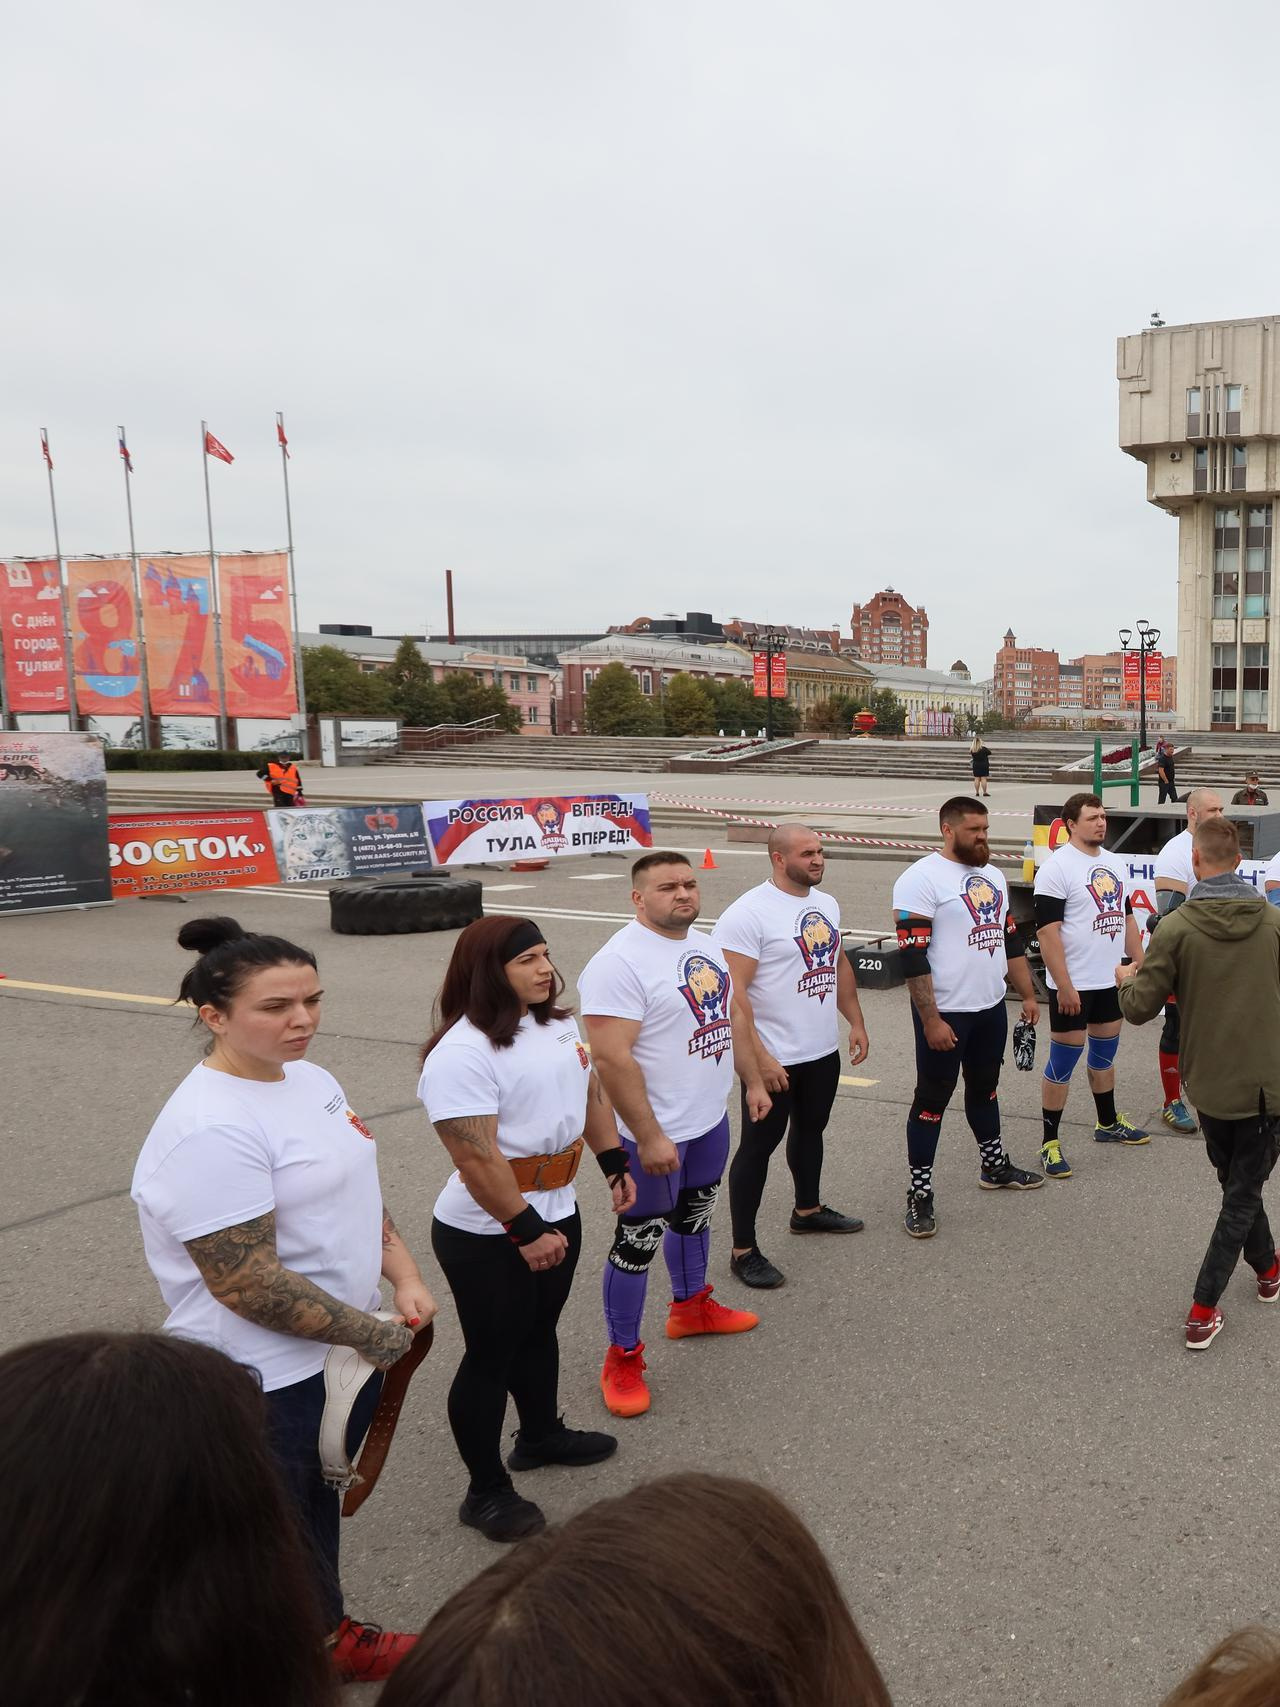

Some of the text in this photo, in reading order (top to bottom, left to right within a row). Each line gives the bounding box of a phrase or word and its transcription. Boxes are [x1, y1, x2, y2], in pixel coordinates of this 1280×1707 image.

[449, 801, 633, 824] РОССИЯ ВПЕРЕД!
[486, 829, 630, 852] ТУЛА ВПЕРЕД!
[858, 958, 882, 971] 220
